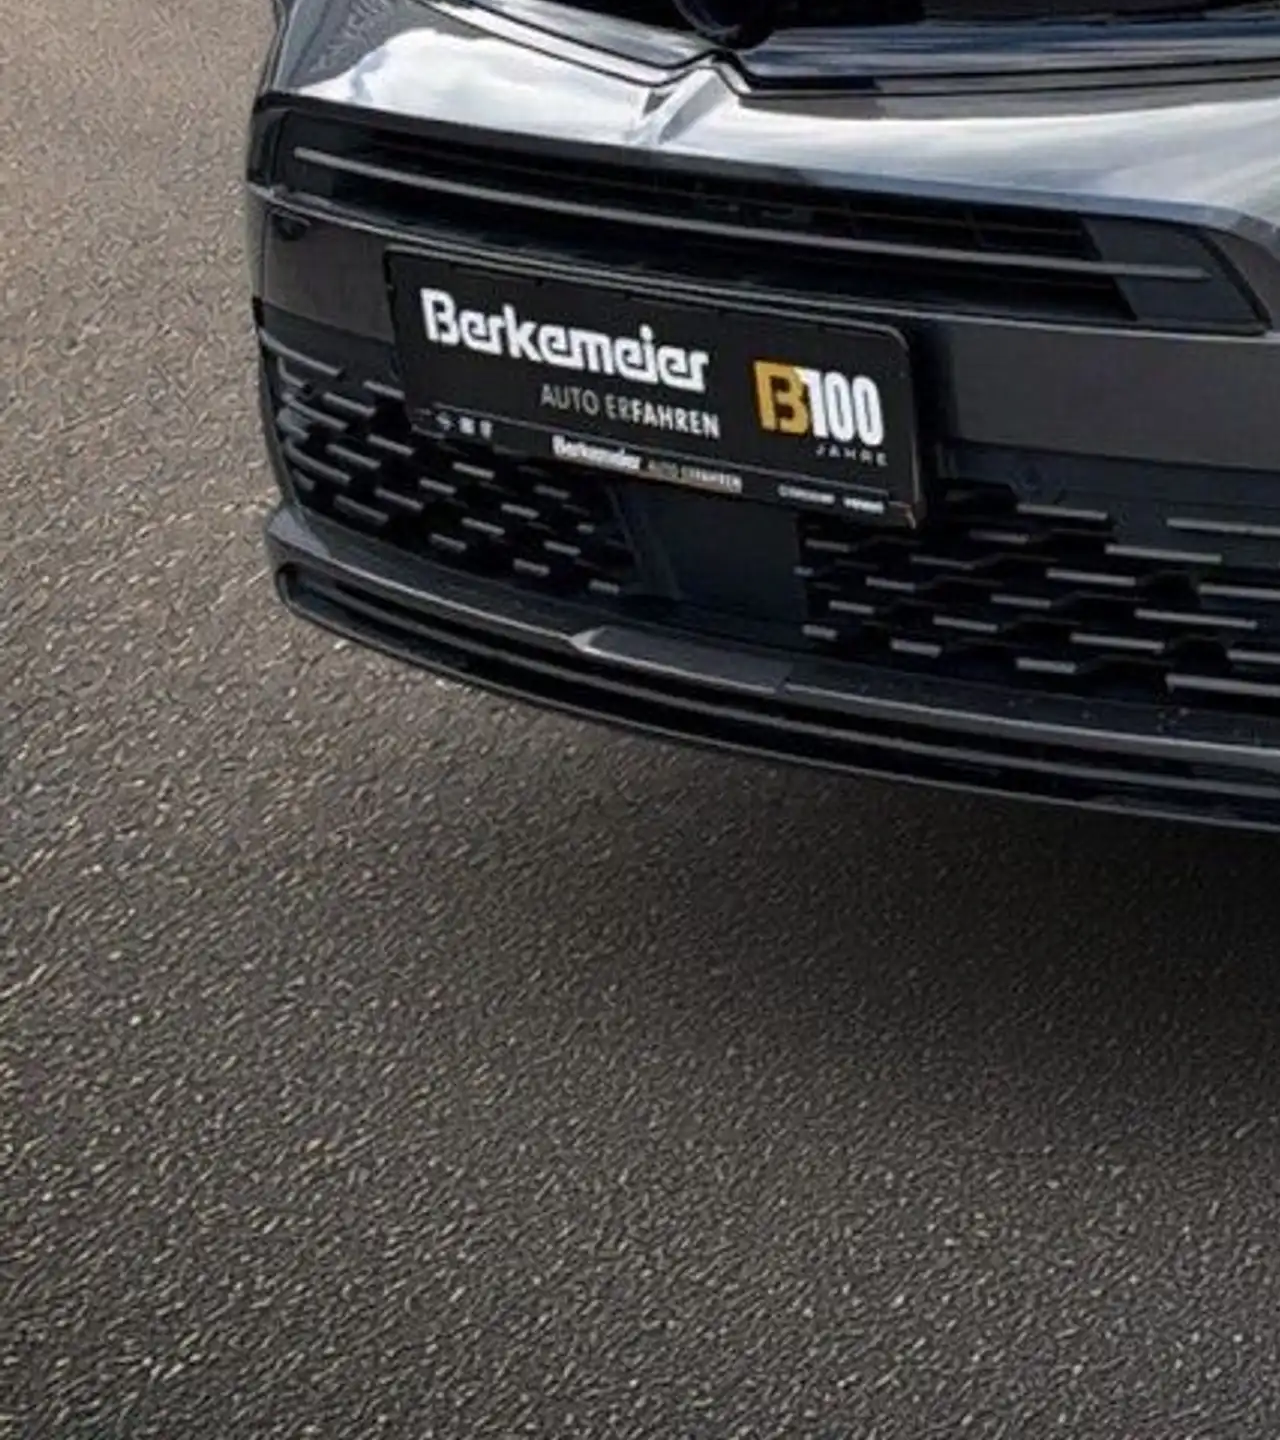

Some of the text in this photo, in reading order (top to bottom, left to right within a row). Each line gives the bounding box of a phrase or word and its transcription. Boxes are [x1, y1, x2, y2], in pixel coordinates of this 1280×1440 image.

[420, 288, 709, 392] Berkemeier
[540, 383, 721, 440] AUTO ERFAHREN
[815, 444, 888, 467] JAHRE
